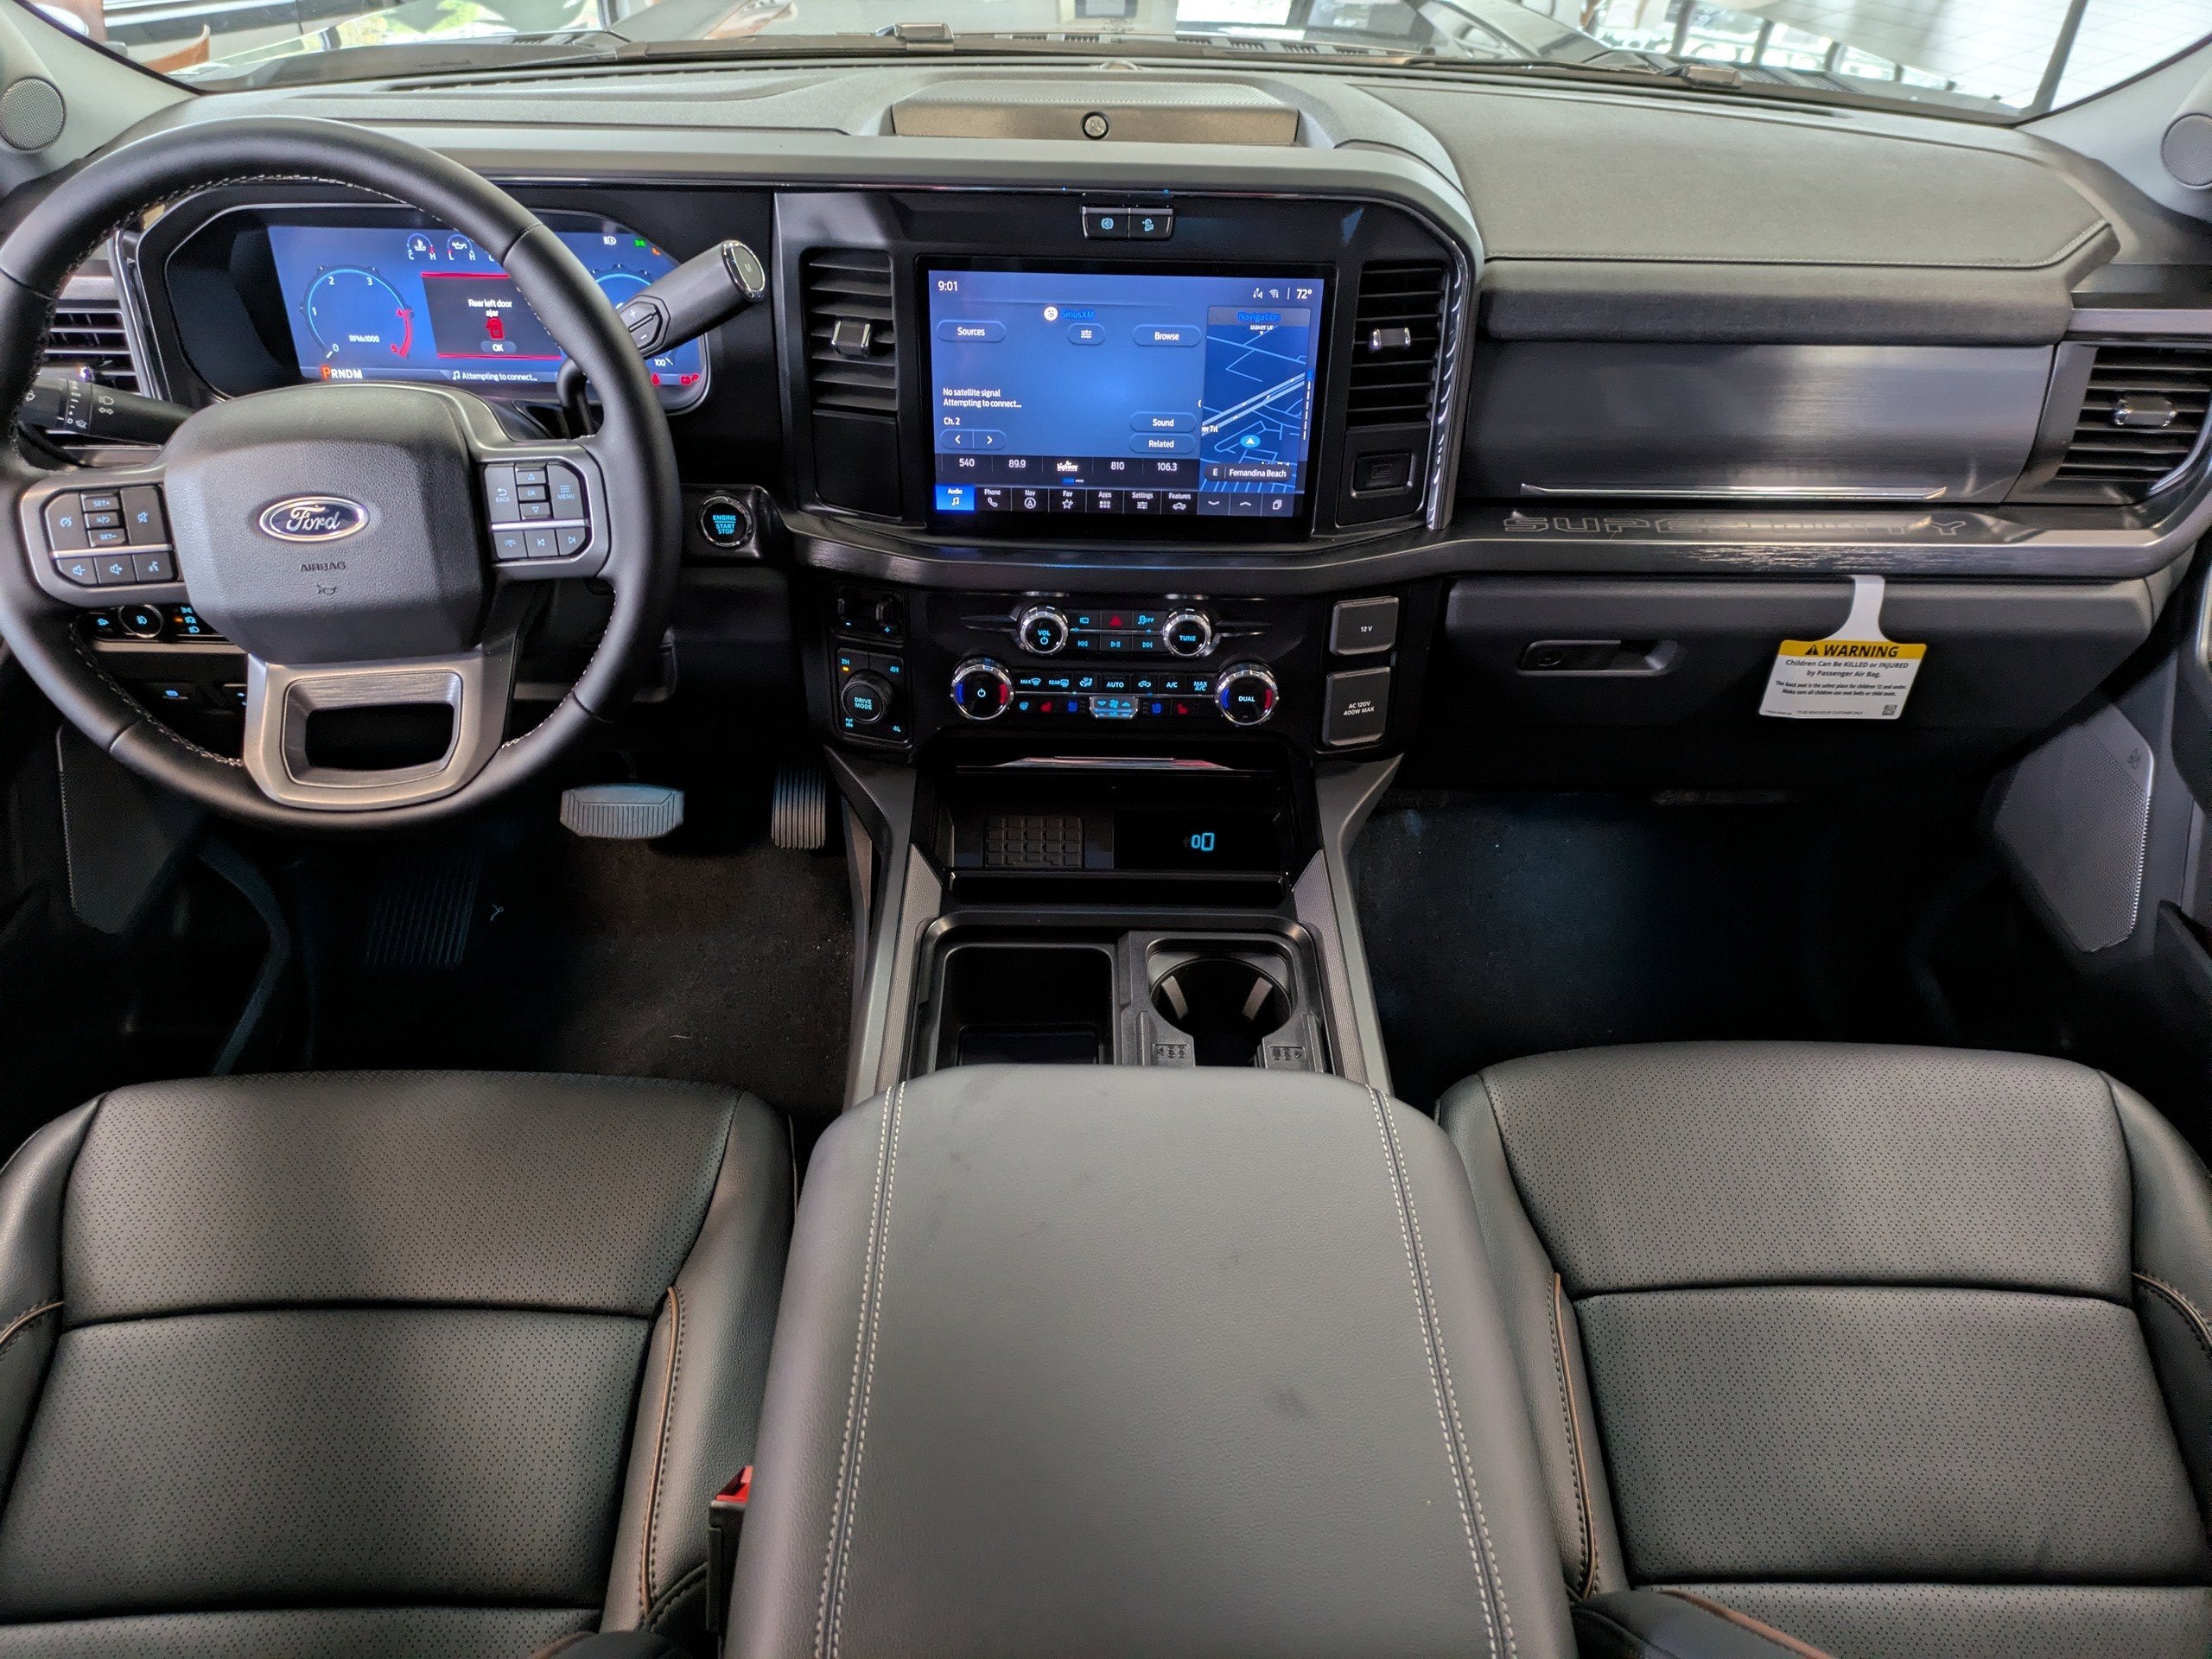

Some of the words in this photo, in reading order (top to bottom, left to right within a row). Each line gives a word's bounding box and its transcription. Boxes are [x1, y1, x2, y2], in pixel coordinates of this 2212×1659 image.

[328, 276, 335, 285] 2
[366, 276, 373, 286] 3
[938, 281, 958, 291] 9:01
[1296, 289, 1313, 299] 72°
[484, 299, 496, 308] left
[497, 299, 512, 308] door
[1060, 310, 1095, 319] SiriusXM
[1237, 312, 1281, 322] Navigation
[957, 327, 985, 336] Sources
[1154, 332, 1179, 340] Browse
[333, 344, 340, 353] 0
[462, 372, 499, 382] Attempting
[981, 389, 1001, 397] signal
[943, 399, 982, 408] Attempting
[1153, 418, 1174, 427] Sound
[1148, 440, 1174, 448] Related
[959, 458, 975, 467] 540
[1008, 460, 1027, 468] 89.9
[1110, 461, 1125, 470] 810
[1157, 462, 1178, 471] 106.3
[1229, 468, 1266, 477] Fernandina
[1267, 468, 1287, 478] Beach
[286, 505, 340, 531] Ford
[301, 562, 346, 571] AIRBAG
[1824, 645, 1900, 658] WARNING
